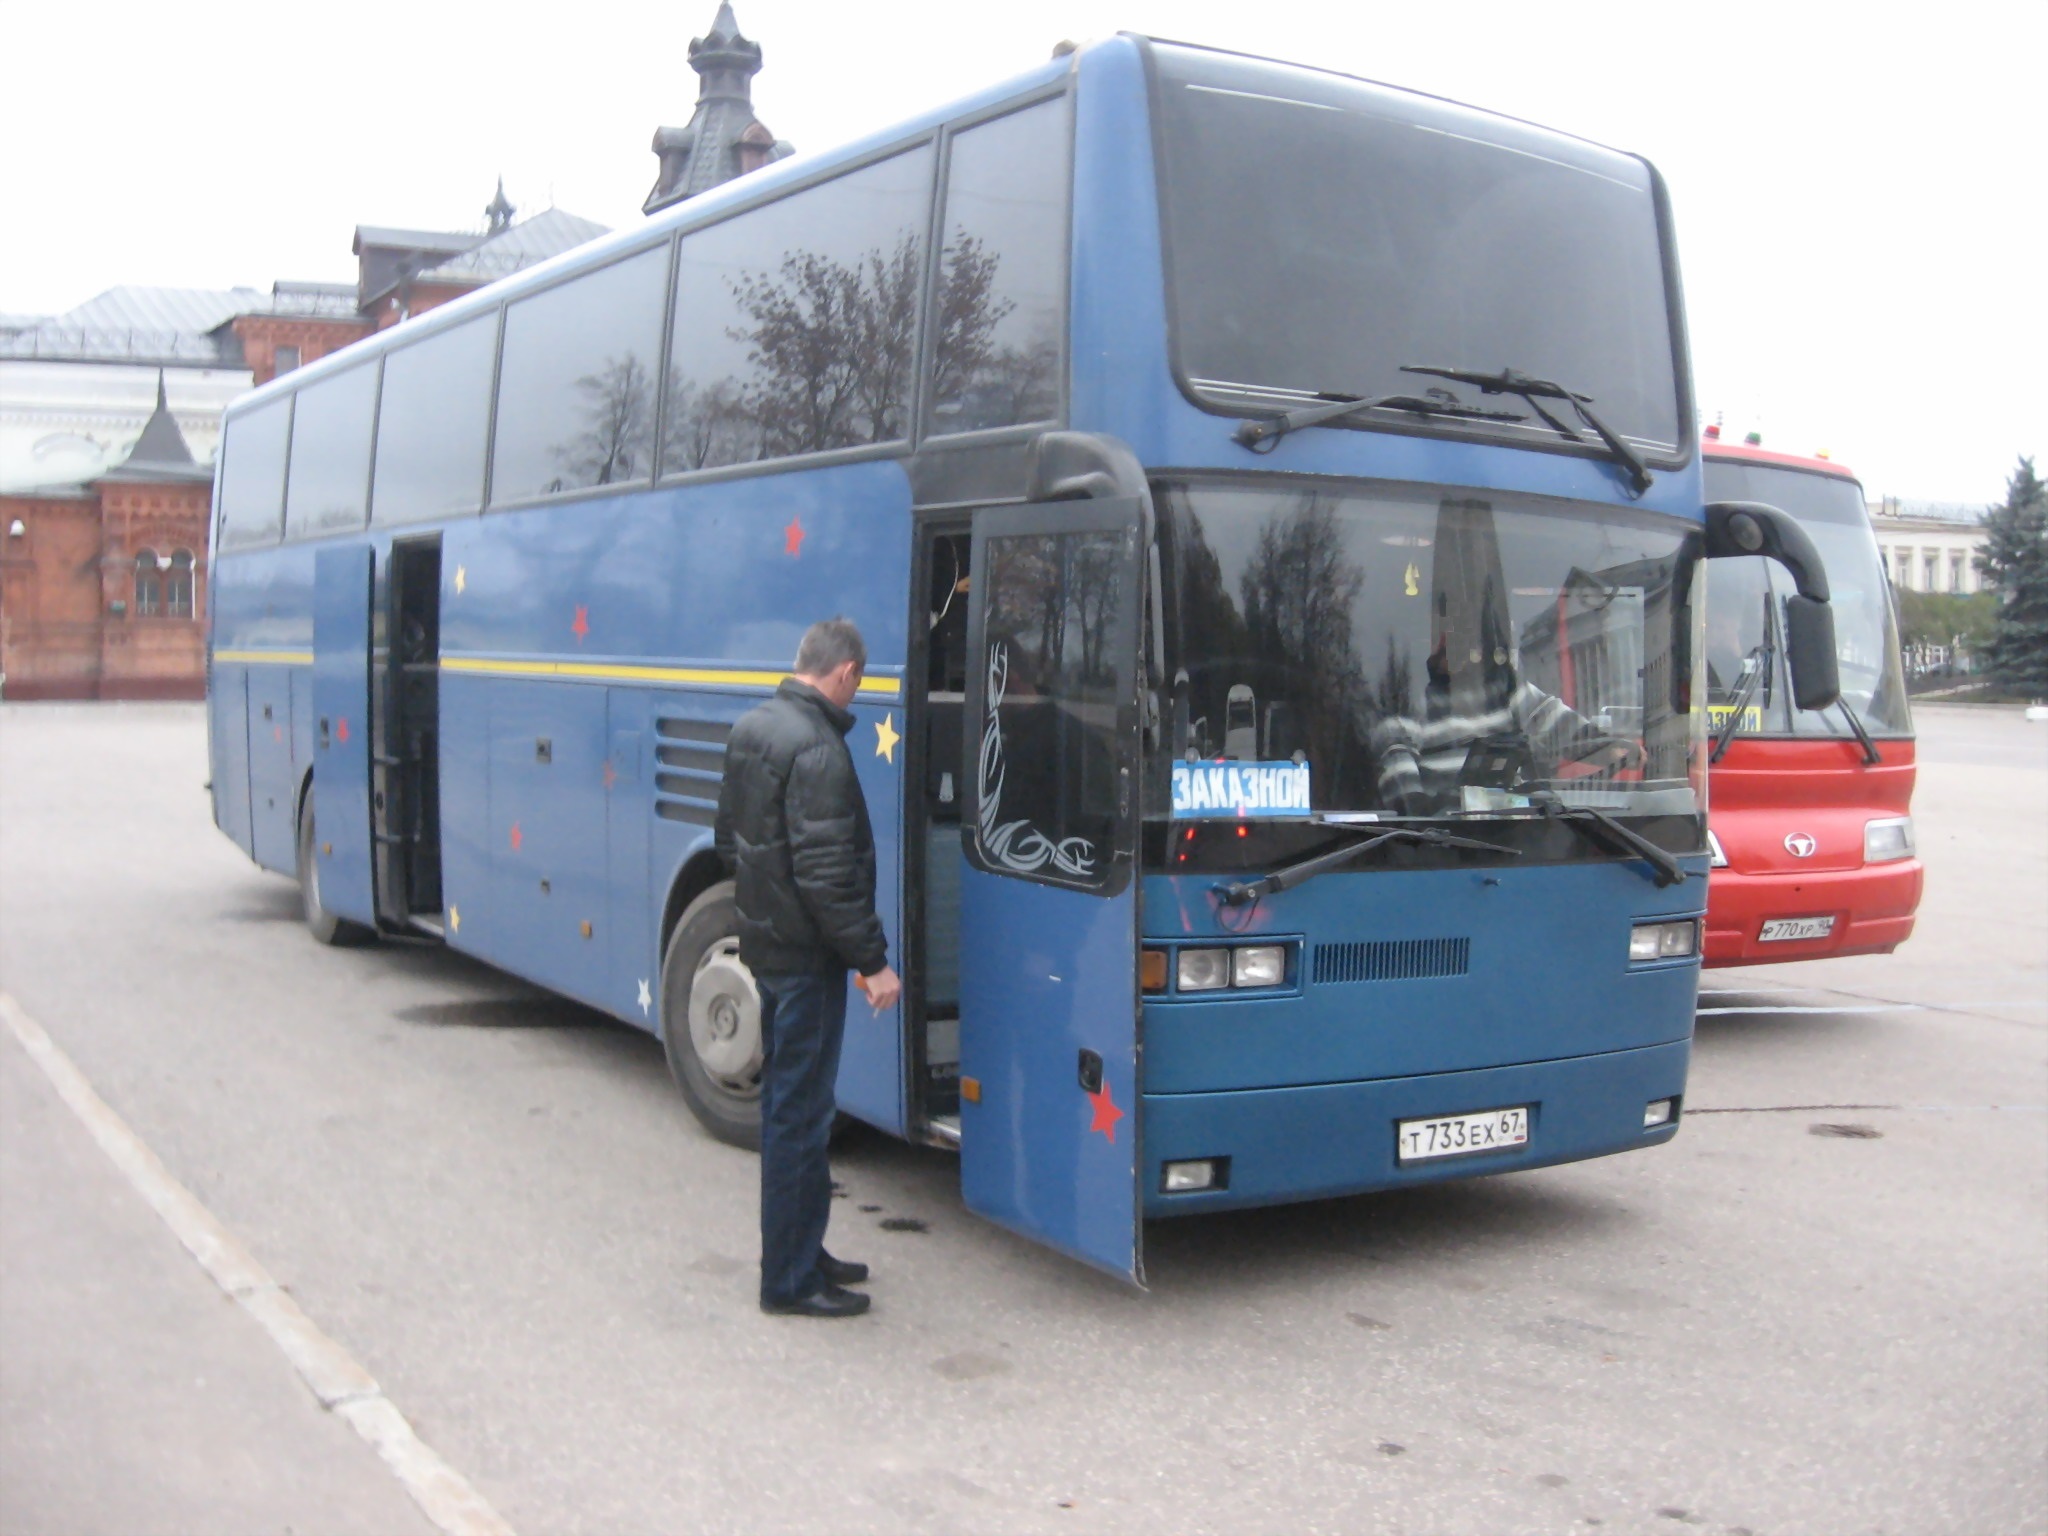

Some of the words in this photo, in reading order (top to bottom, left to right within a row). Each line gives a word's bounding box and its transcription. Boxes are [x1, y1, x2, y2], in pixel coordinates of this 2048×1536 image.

[1172, 764, 1310, 810] ЗАКАЗНОЙ
[1409, 1120, 1495, 1153] Т733ЕХ
[1500, 1112, 1520, 1134] 67
